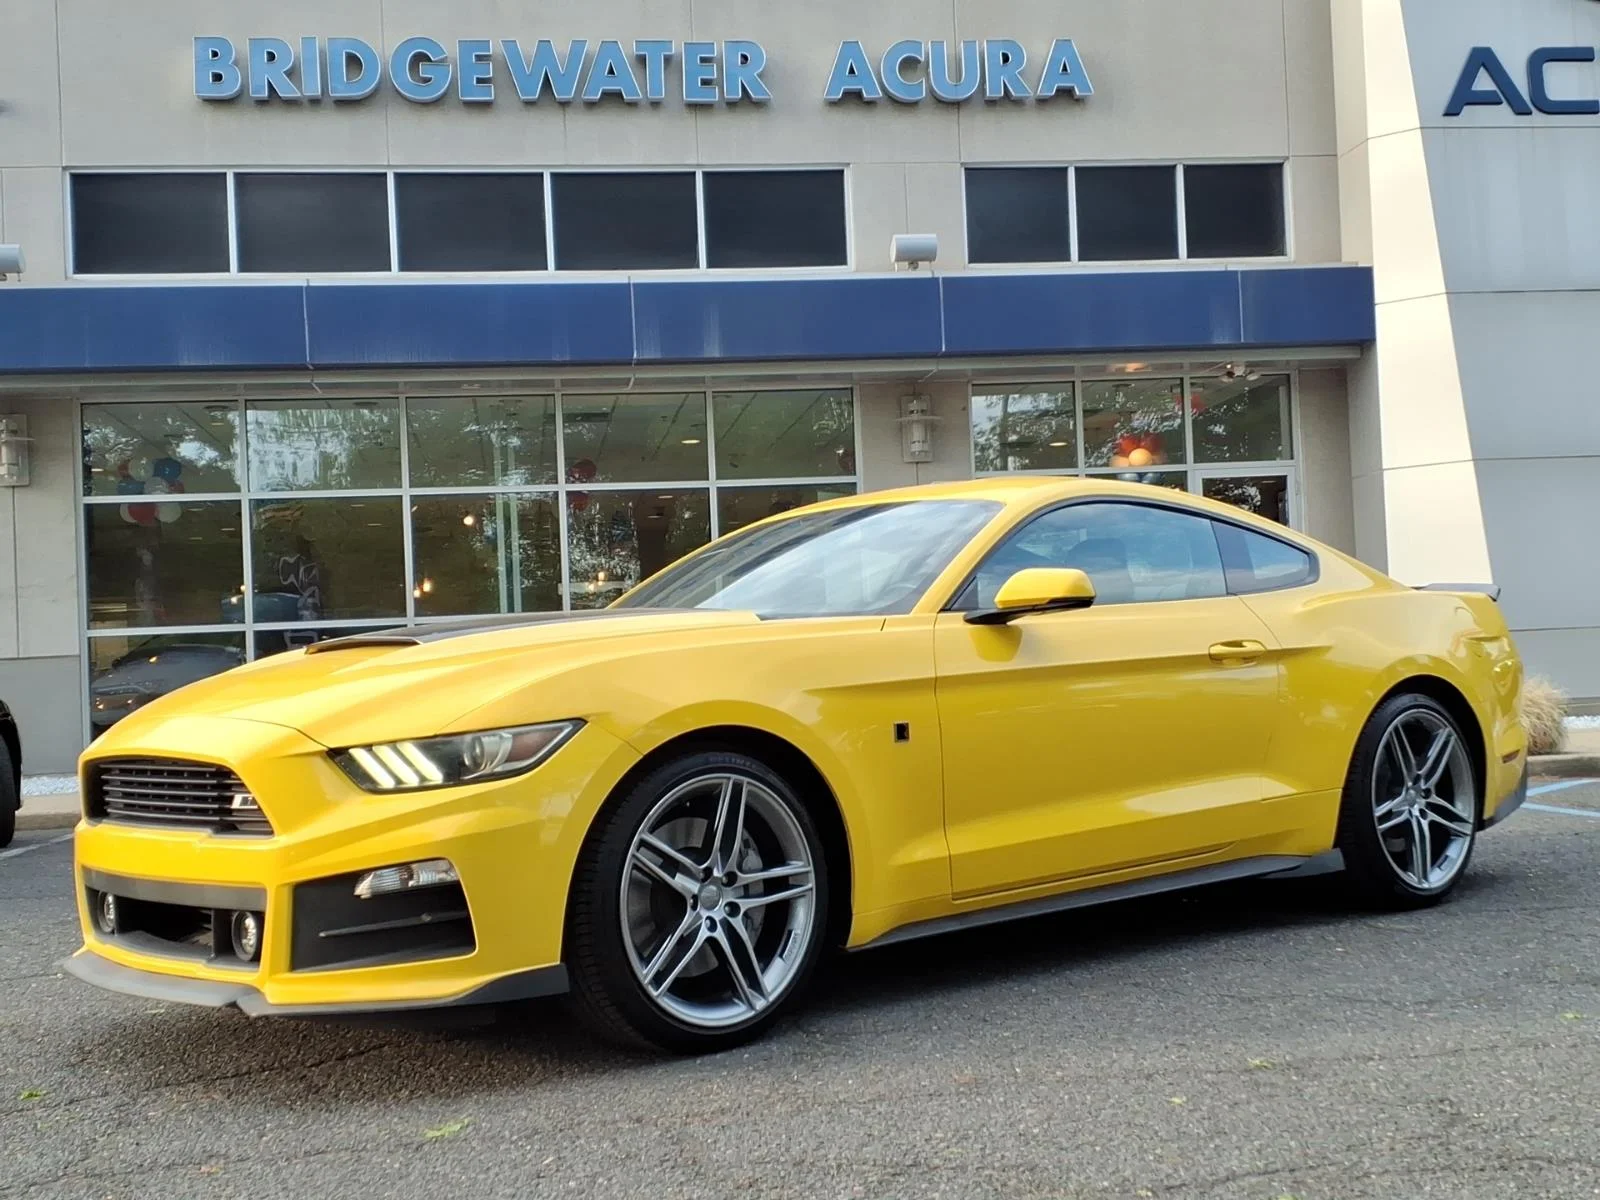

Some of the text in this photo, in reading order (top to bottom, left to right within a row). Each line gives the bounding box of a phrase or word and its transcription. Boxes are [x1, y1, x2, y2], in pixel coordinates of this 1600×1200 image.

[192, 36, 1095, 103] BRIDGEWATER ACURA
[1442, 46, 1600, 116] AC
